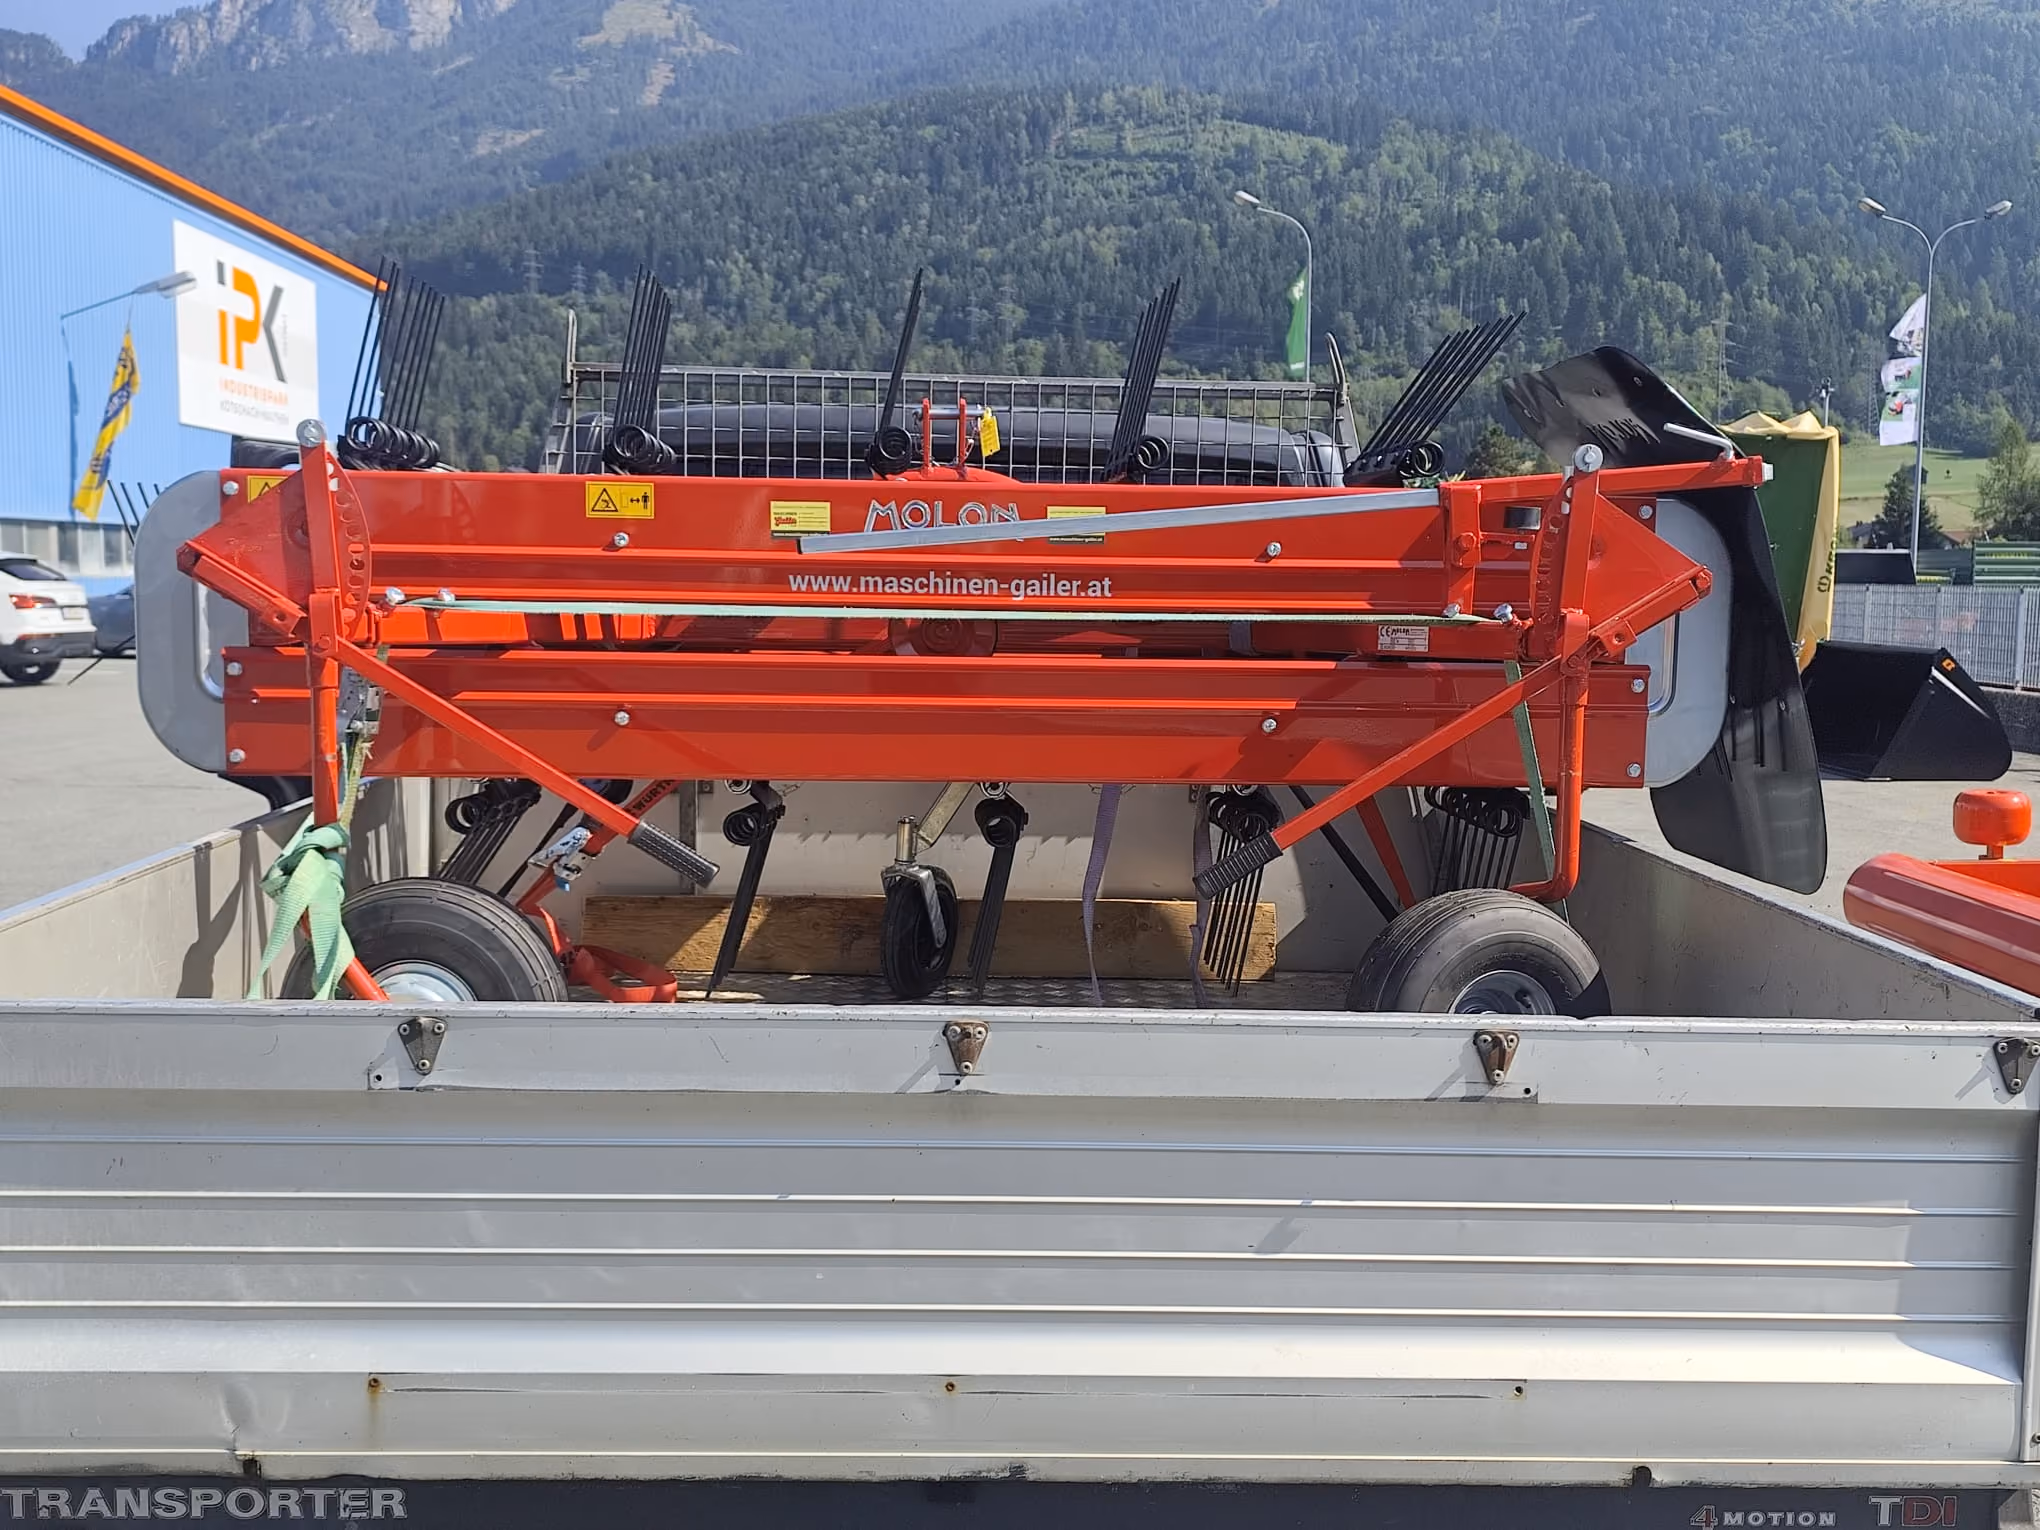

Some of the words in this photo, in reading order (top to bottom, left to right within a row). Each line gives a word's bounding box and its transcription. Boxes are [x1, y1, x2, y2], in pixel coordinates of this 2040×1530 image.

[864, 500, 1024, 541] MOLON
[788, 571, 1112, 600] www.maschinen-gailer.at
[1, 1487, 408, 1520] TRANSPORTER
[1869, 1495, 1957, 1527] TDI
